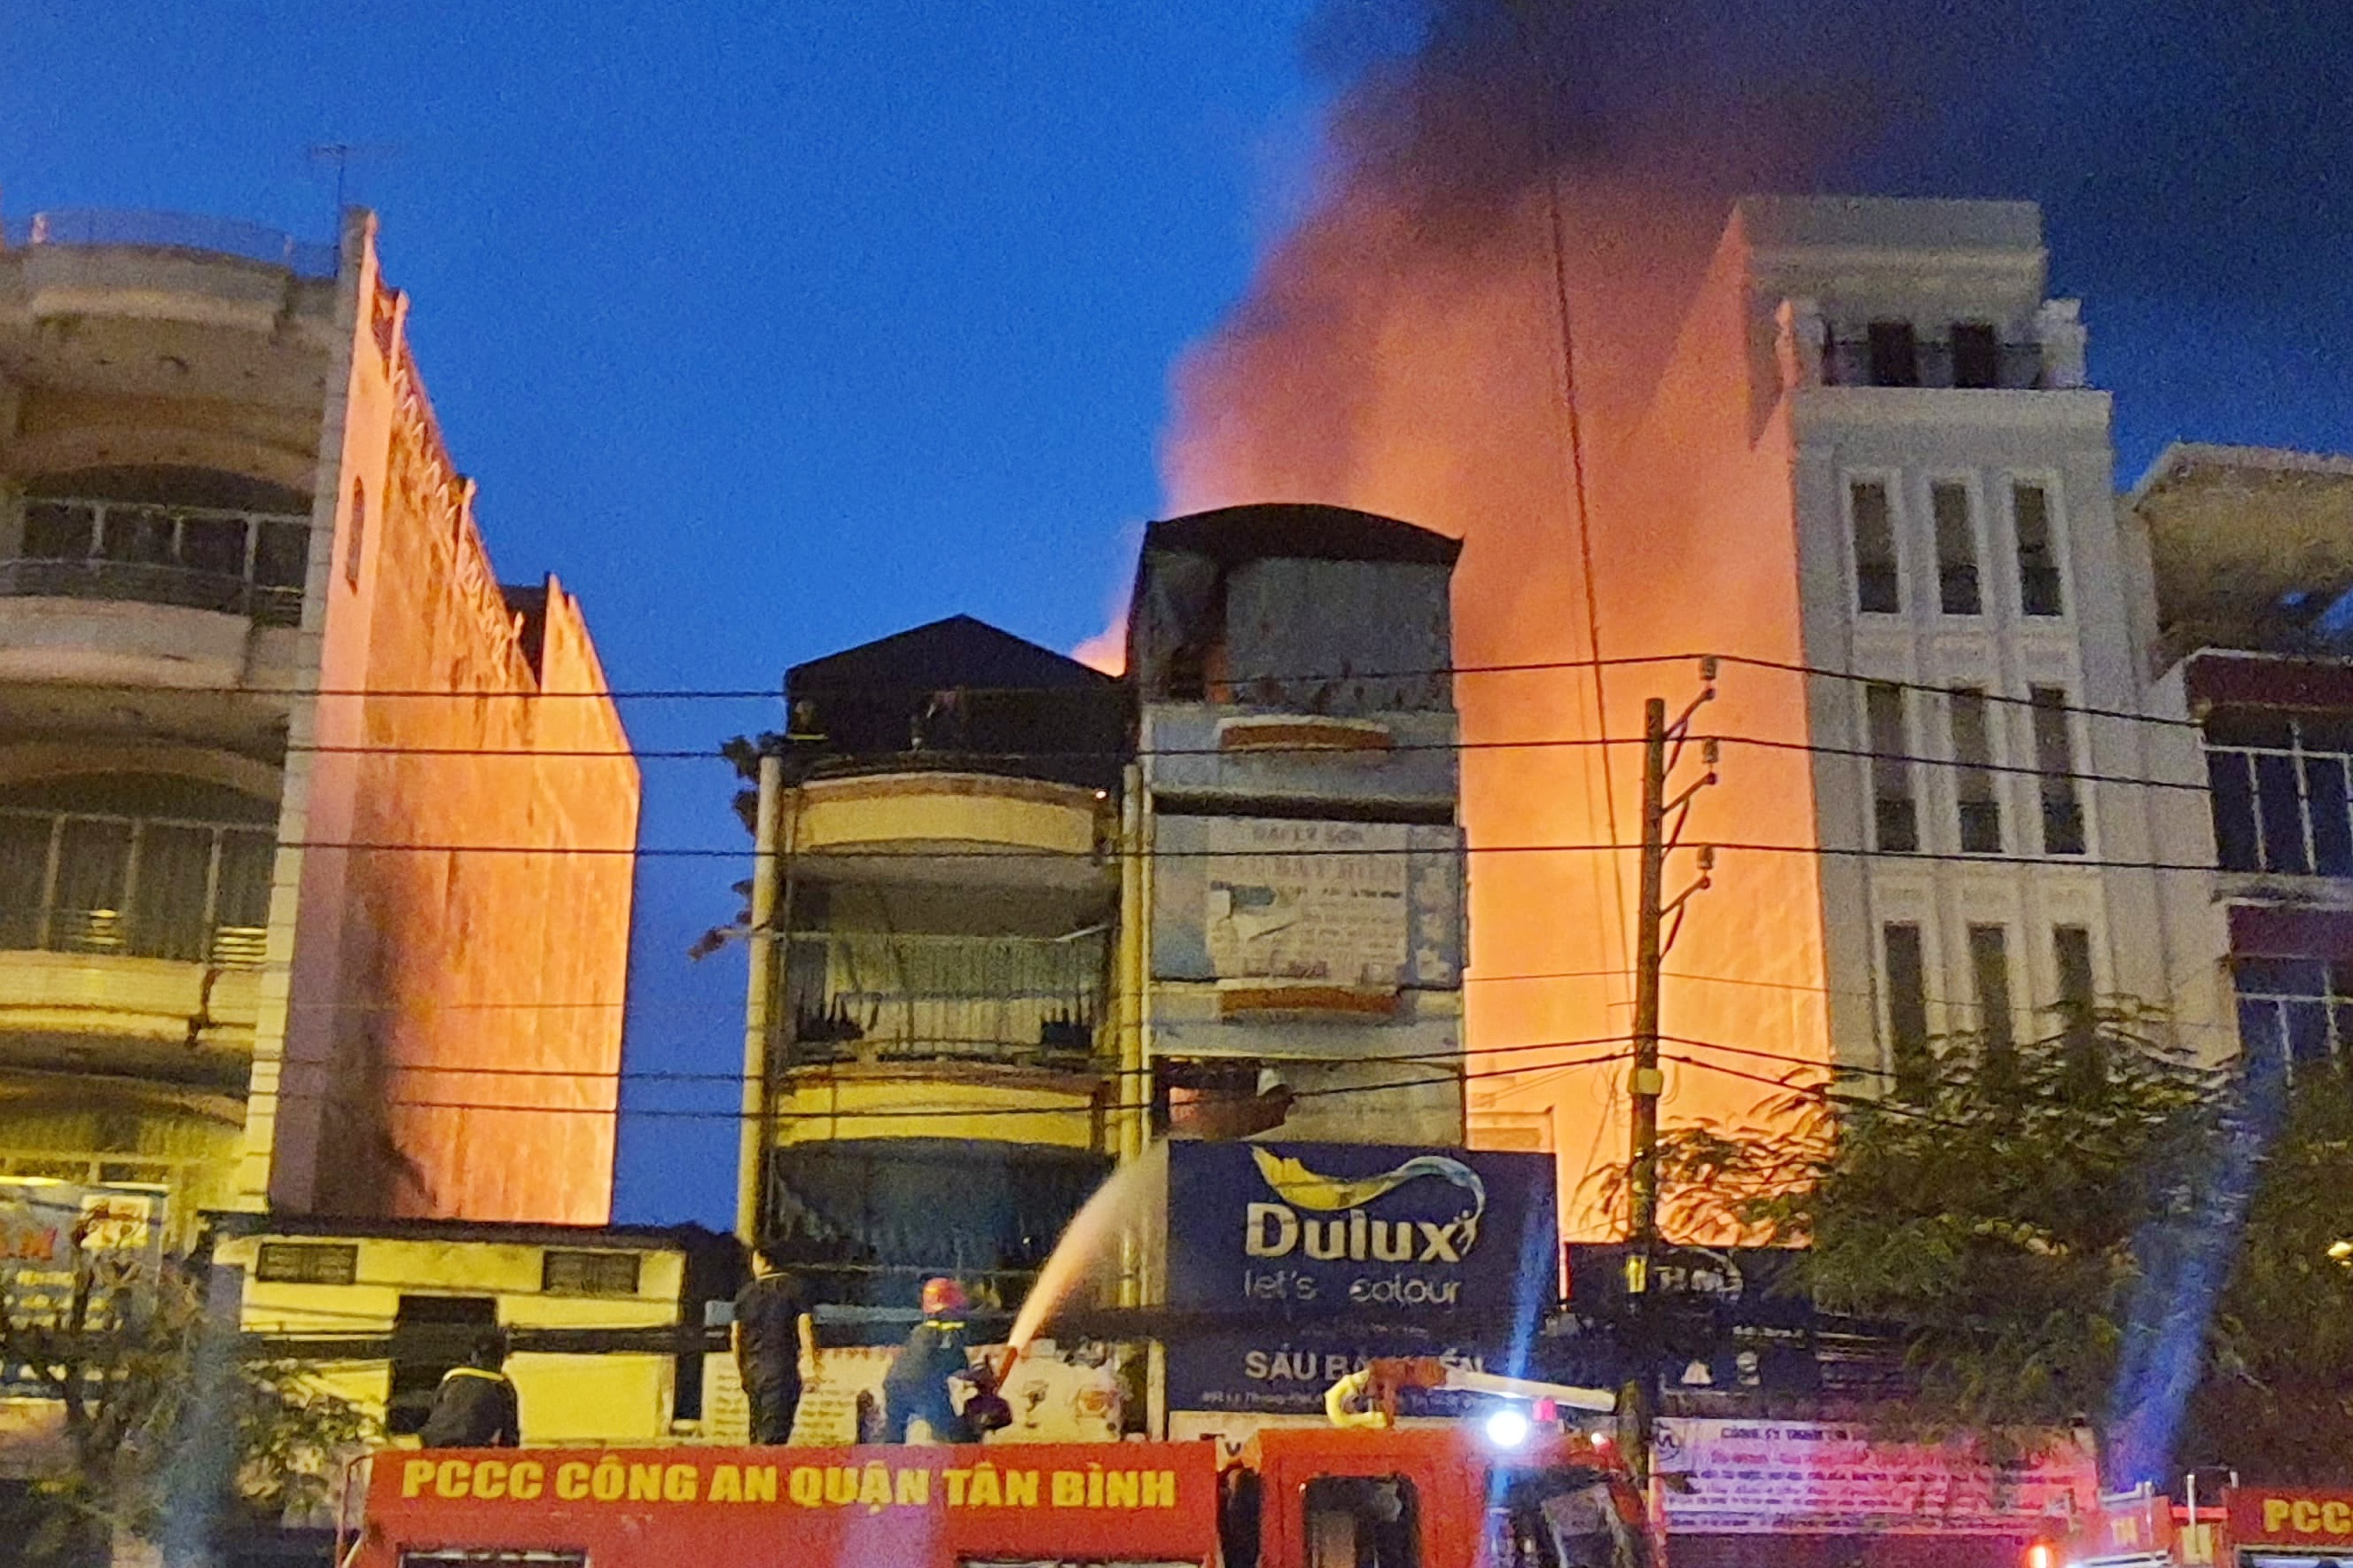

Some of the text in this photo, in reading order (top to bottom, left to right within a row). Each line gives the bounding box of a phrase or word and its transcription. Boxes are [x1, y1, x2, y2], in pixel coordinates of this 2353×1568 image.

[1246, 1202, 1461, 1263] Dulux
[1244, 1269, 1461, 1305] let's colour
[402, 1454, 1176, 1516] PCCC CÔNG AN QUẬN TÂN BÌNH
